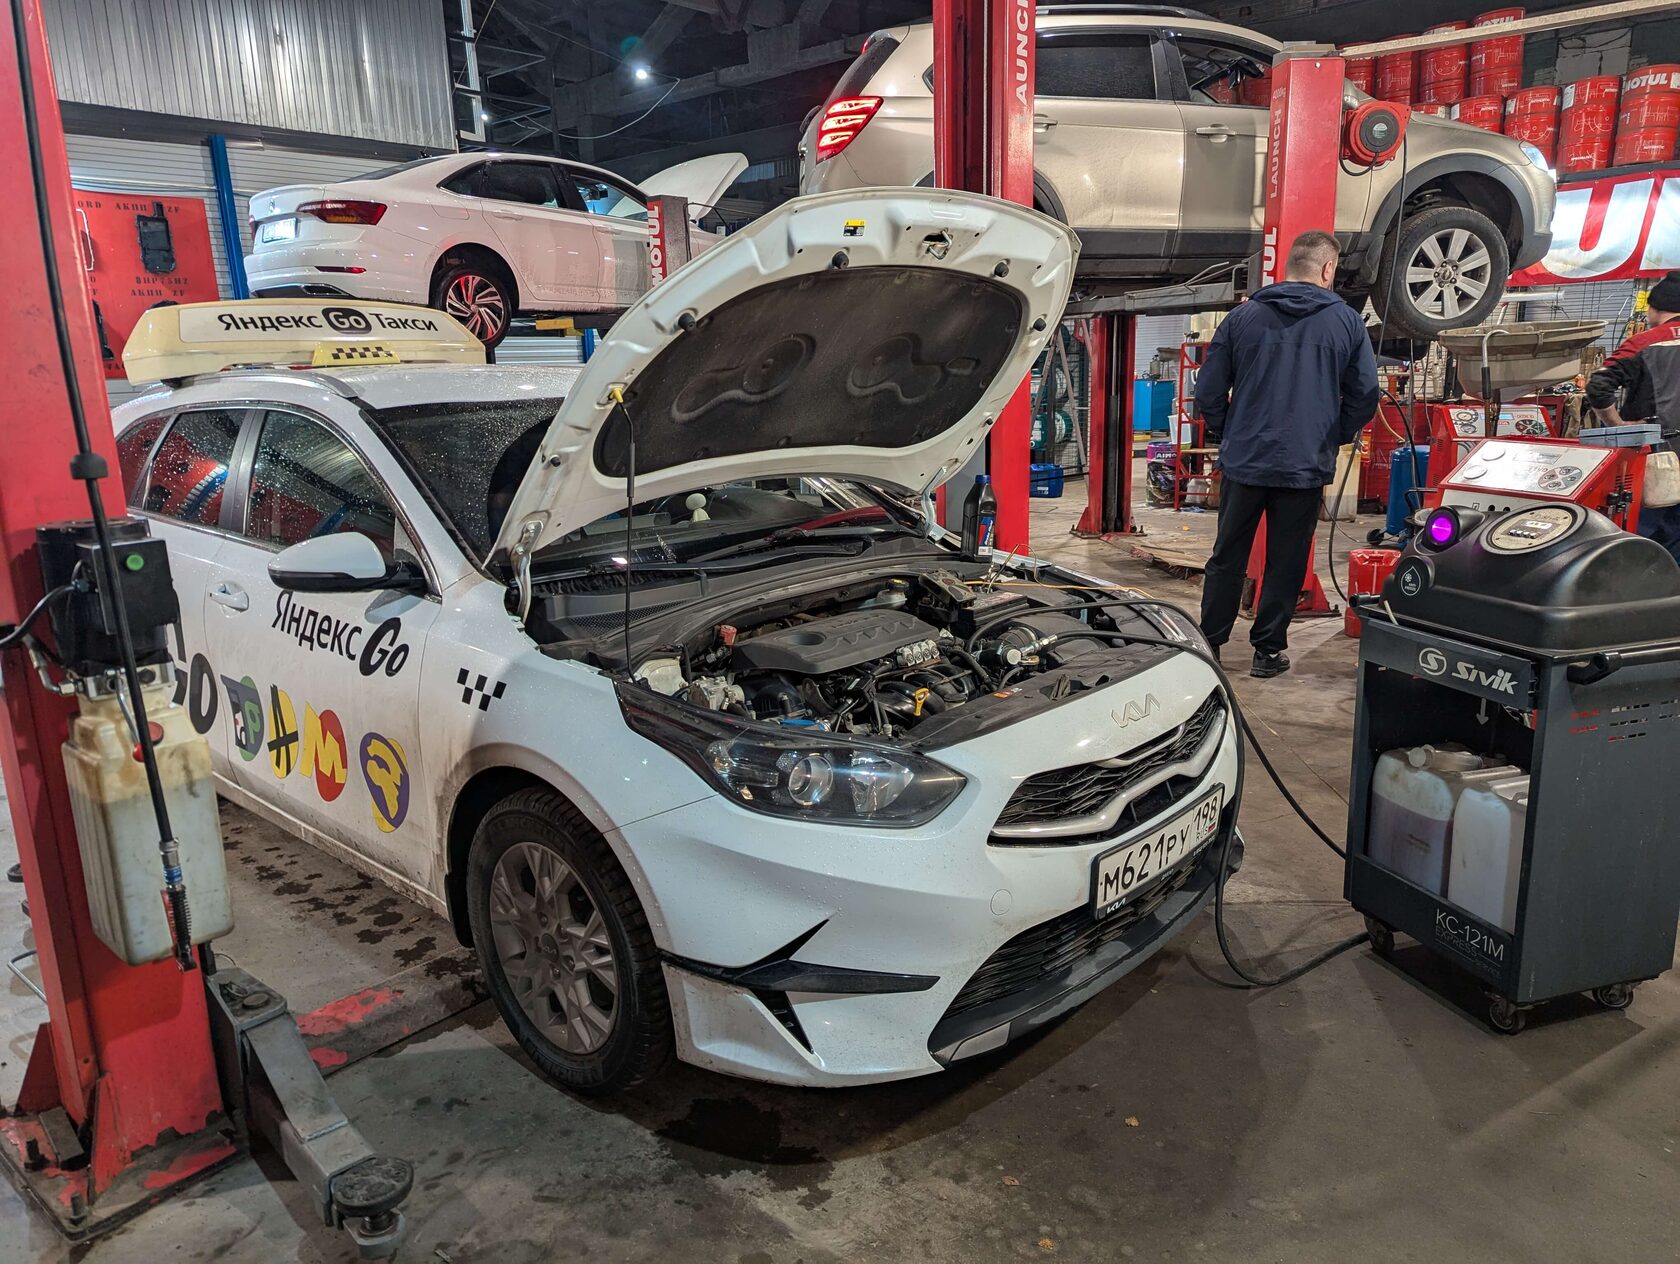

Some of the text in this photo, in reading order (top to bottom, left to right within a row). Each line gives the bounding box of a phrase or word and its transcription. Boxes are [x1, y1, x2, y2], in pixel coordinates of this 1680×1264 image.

[1270, 109, 1282, 199] LAUNCH
[217, 310, 438, 332] Яндекс Go Такси
[271, 590, 410, 678] Яндекс Go
[1193, 796, 1218, 831] 198
[1435, 926, 1477, 957] EXPRESS
